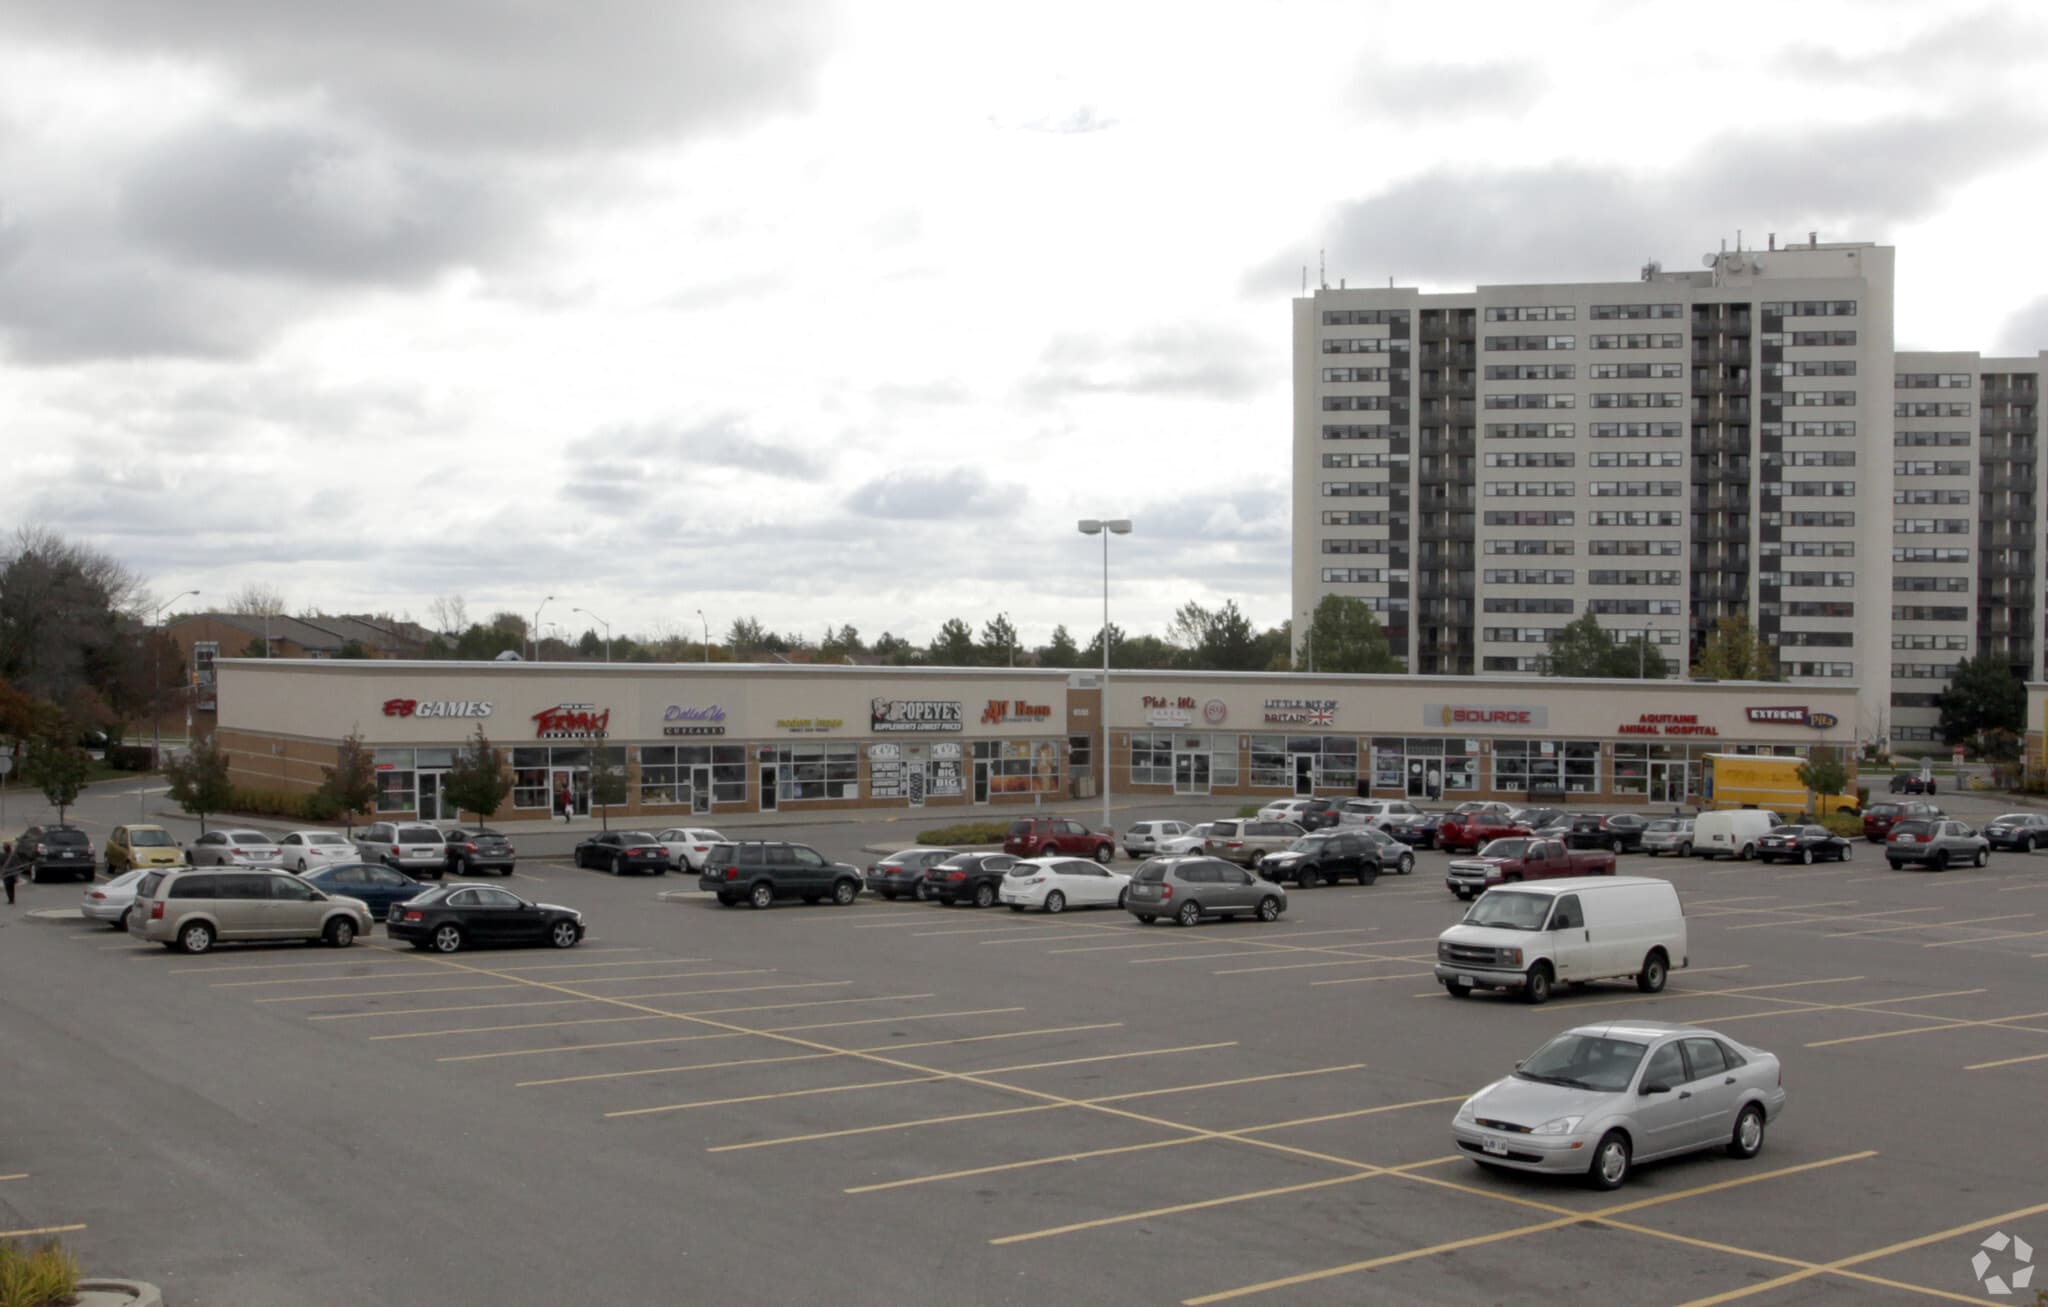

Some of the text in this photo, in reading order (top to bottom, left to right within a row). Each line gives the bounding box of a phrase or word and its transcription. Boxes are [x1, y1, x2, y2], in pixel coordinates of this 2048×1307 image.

[383, 698, 493, 717] EB GAMES
[1264, 699, 1337, 710] LITTLE BIT OF
[899, 702, 962, 720] POPEYE'S
[1454, 709, 1531, 724] SOURCE
[1751, 709, 1804, 720] EXTREME
[1264, 714, 1306, 722] BRITAIN
[1639, 714, 1698, 724] AQUITAINE
[1618, 724, 1719, 737] ANIMAL HOSPITAL
[938, 768, 956, 777] BIG
[936, 779, 957, 787] BIG
